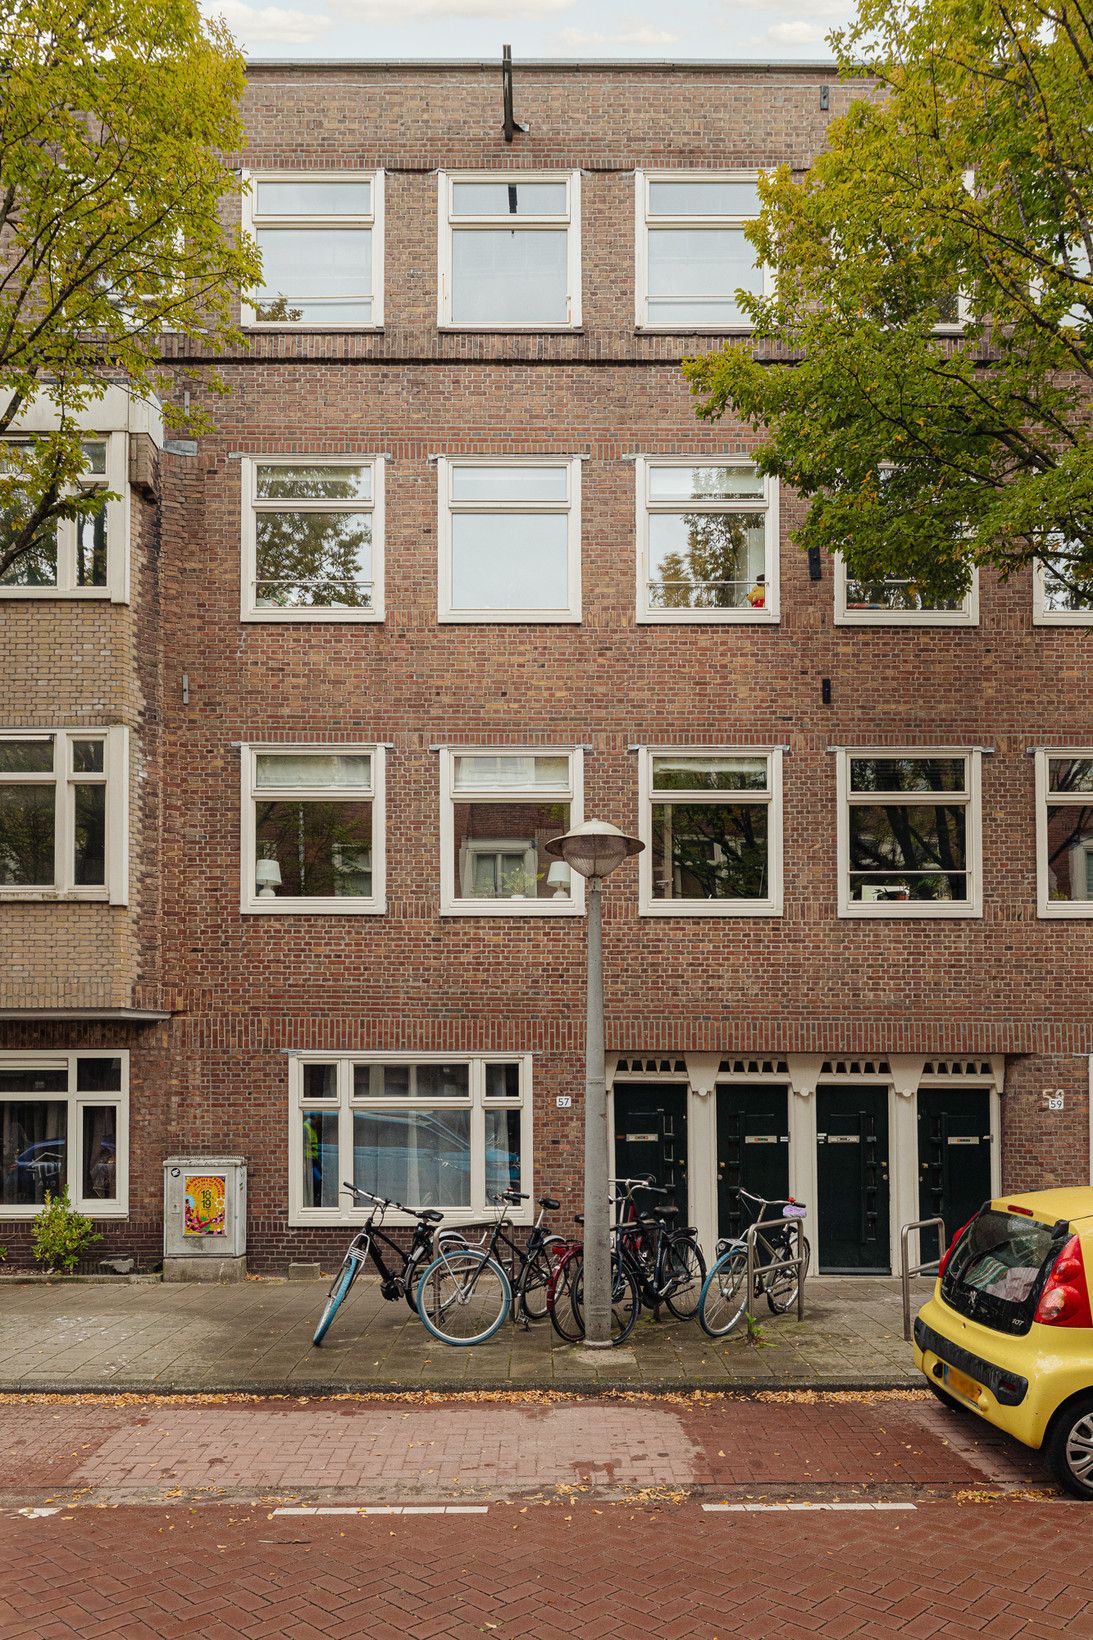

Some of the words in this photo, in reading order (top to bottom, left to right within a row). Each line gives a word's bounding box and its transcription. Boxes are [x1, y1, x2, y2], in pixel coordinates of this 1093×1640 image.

[558, 1097, 569, 1106] 57
[1050, 1100, 1062, 1108] 59
[201, 1190, 211, 1199] 18
[201, 1200, 211, 1208] 19
[1012, 1318, 1024, 1326] 107
